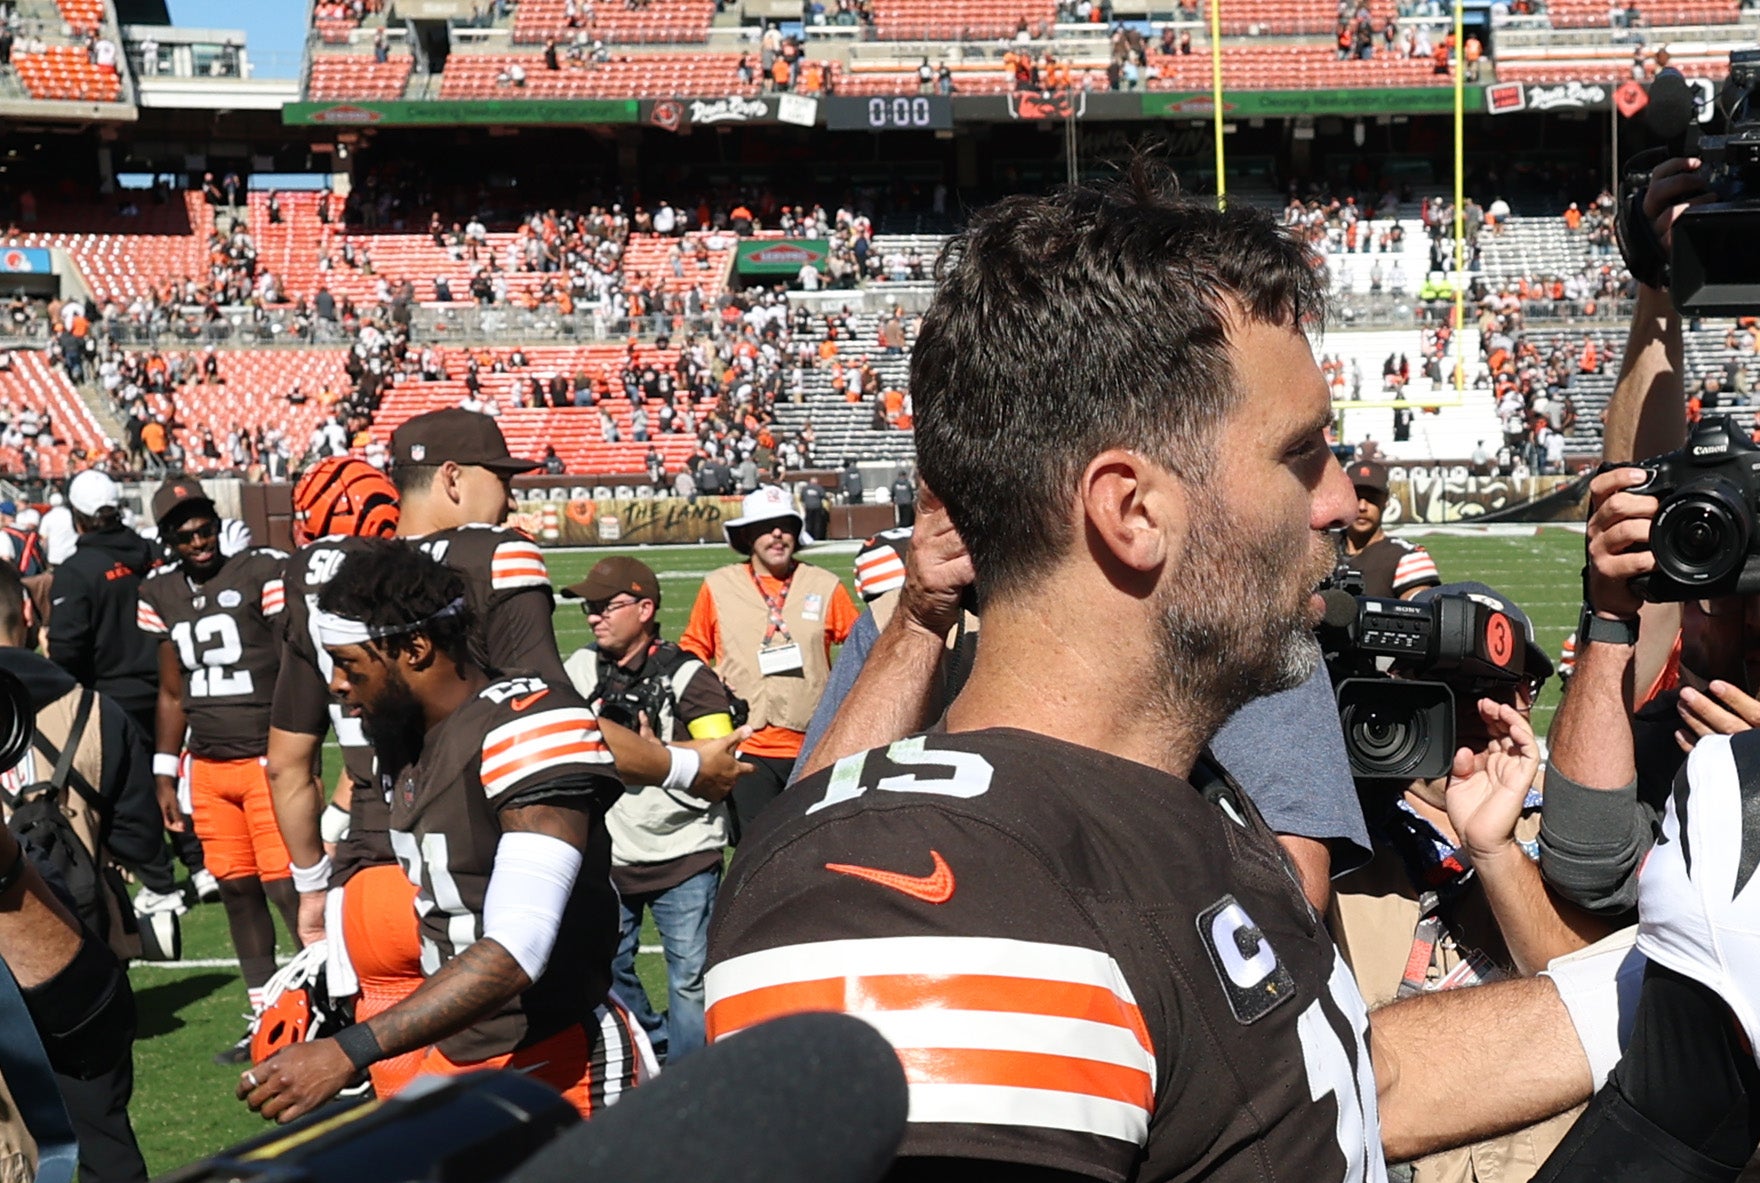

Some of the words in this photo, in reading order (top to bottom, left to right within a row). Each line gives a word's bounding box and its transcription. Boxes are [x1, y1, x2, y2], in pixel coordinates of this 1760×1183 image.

[869, 97, 930, 126] 0:00
[1693, 445, 1727, 456] Canon
[624, 501, 663, 527] THE
[664, 503, 721, 530] LAND
[1395, 605, 1421, 614] SONY
[1494, 621, 1505, 656] 3
[171, 613, 254, 697] 12
[805, 735, 995, 816] 15
[1211, 901, 1278, 989] C
